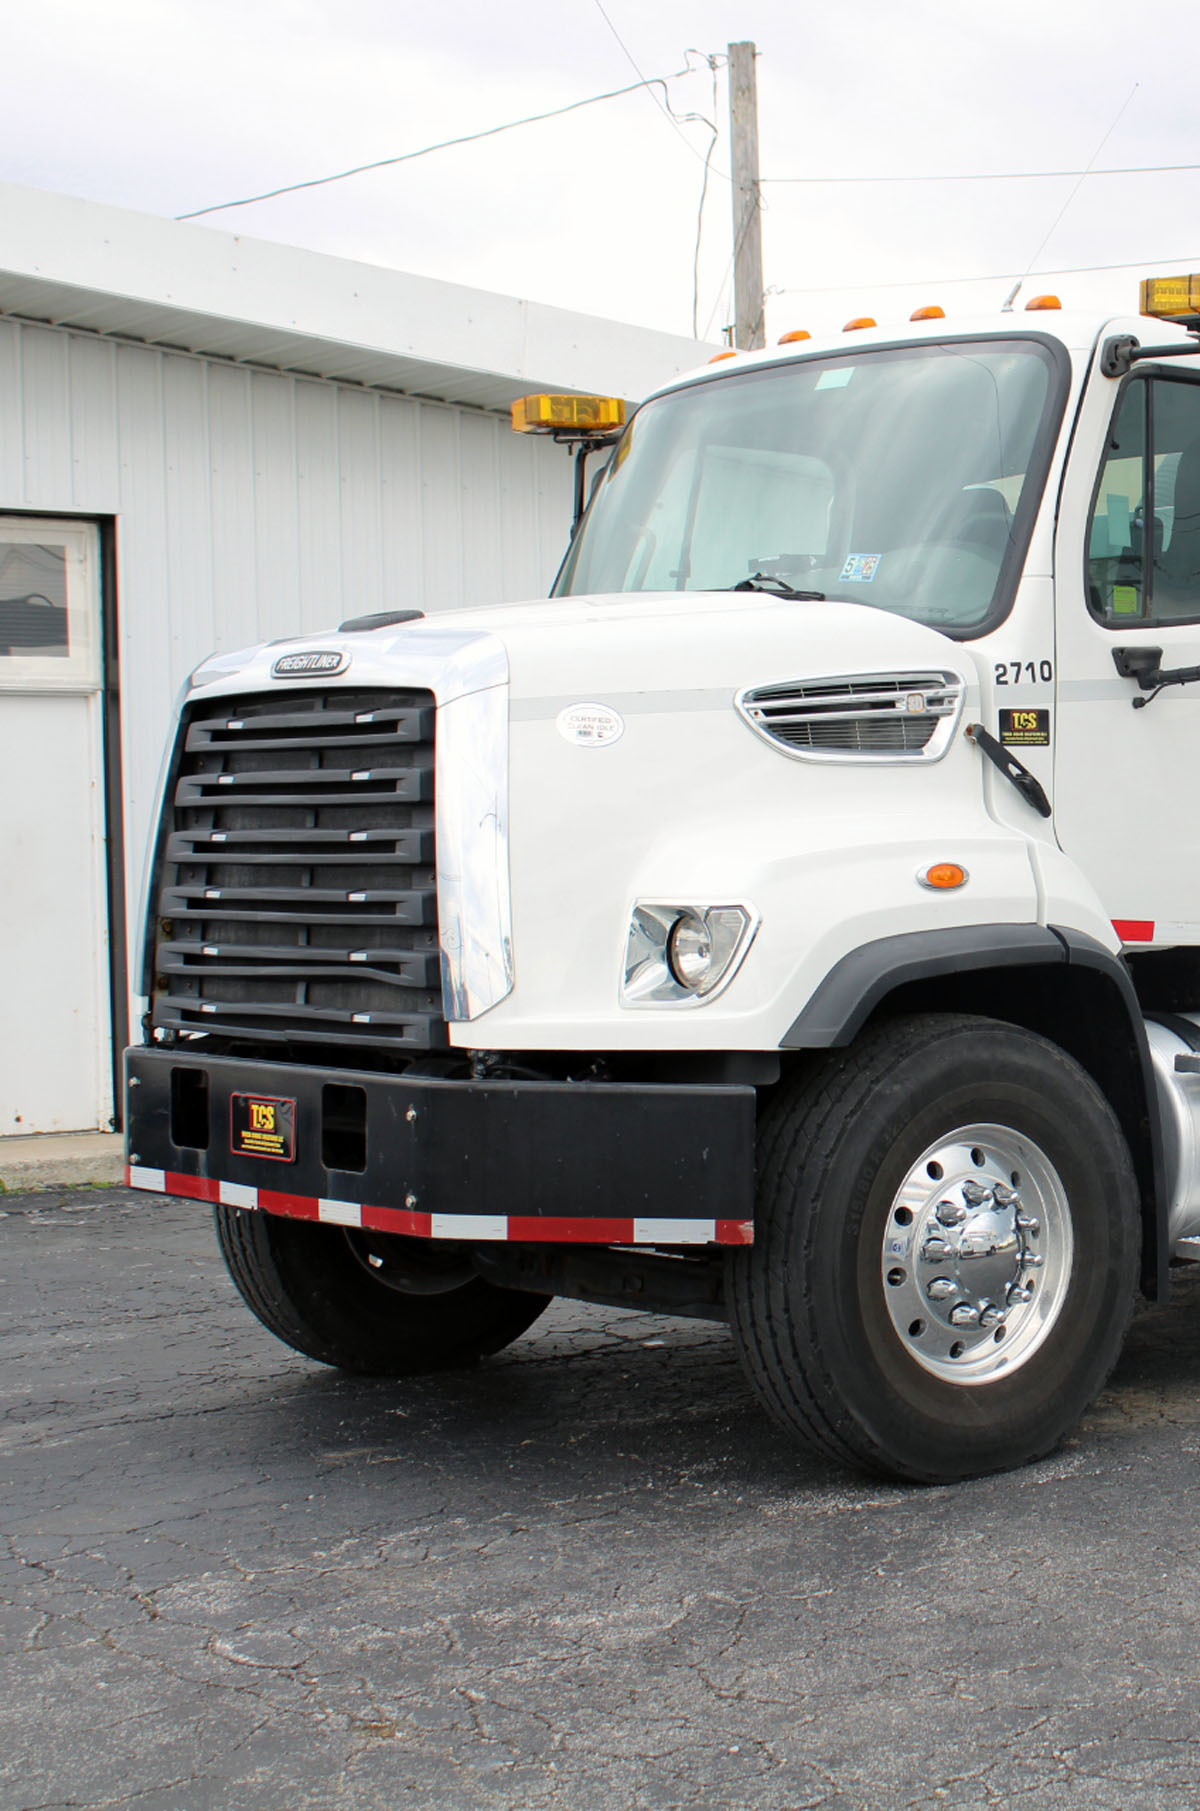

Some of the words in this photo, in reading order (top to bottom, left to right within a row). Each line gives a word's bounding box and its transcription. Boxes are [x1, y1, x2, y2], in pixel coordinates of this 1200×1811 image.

[277, 653, 342, 672] FREIGHTLINER
[994, 660, 1052, 685] 2710
[567, 722, 595, 730] CLEAN
[570, 715, 612, 724] CERTIFIED
[1012, 712, 1037, 730] TCS
[251, 1103, 275, 1130] TCS
